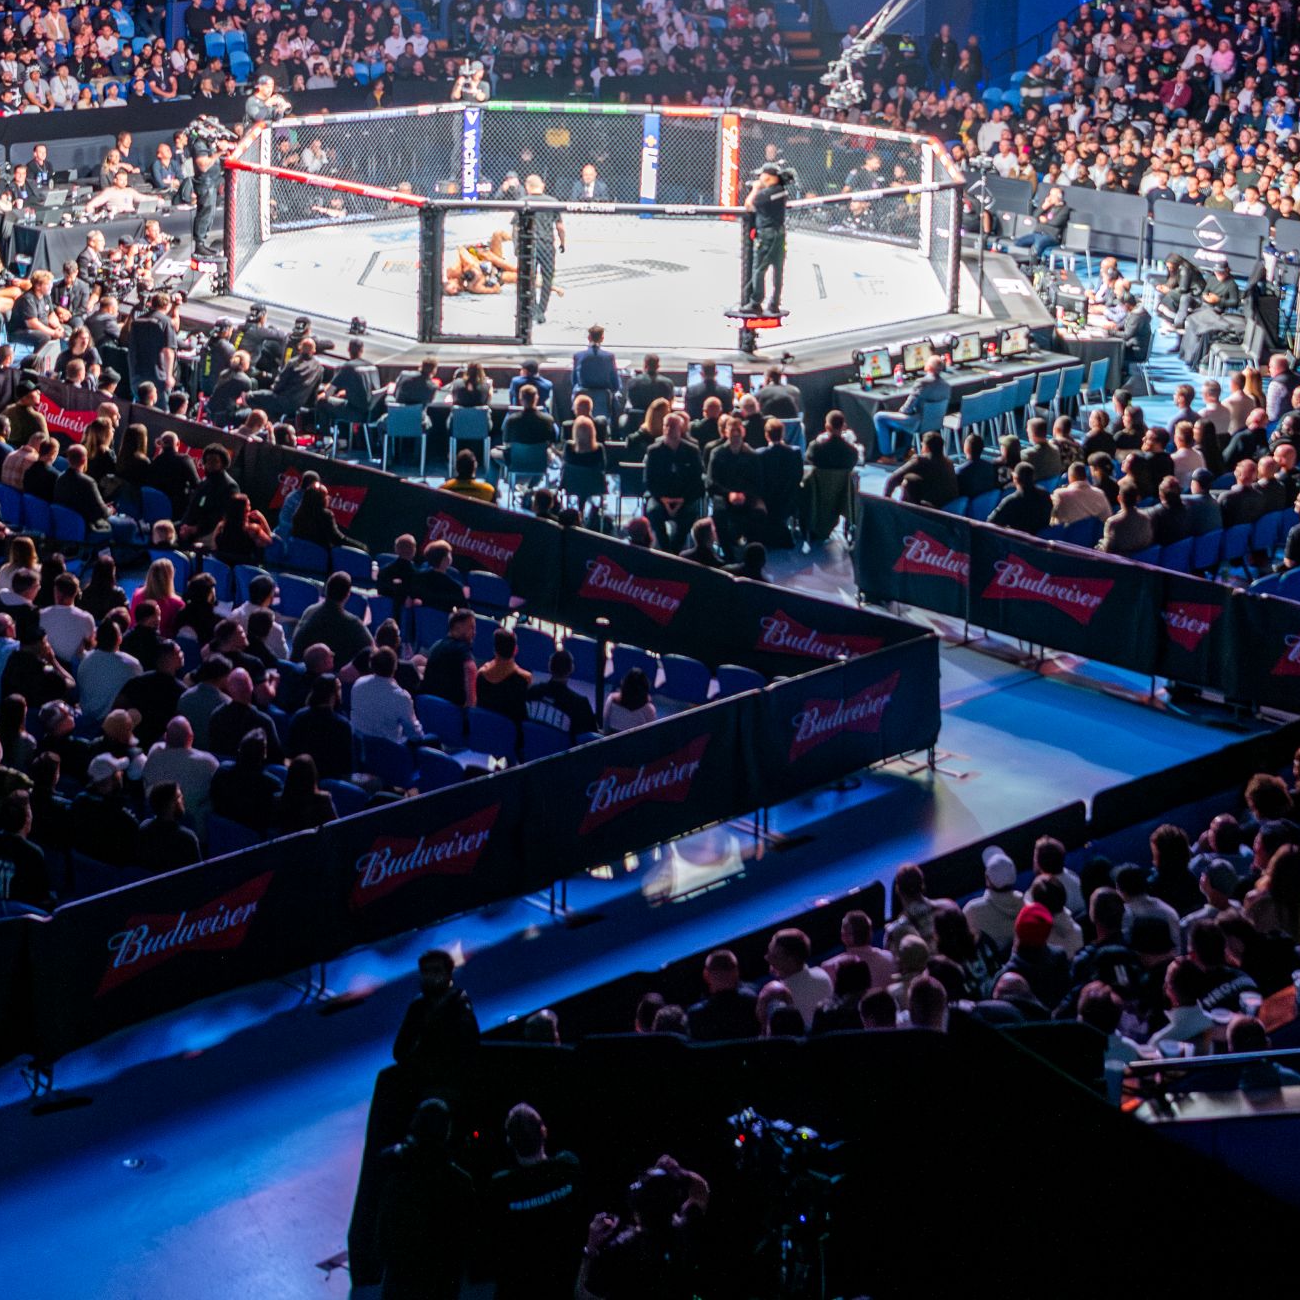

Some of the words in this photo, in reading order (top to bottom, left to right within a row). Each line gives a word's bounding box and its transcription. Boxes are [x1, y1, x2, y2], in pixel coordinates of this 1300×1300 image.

[427, 513, 515, 561] Budweiser
[586, 559, 680, 612] Budweiser
[994, 560, 1102, 607] Budweiser
[792, 694, 891, 742] Budweiser
[586, 761, 699, 813] Budweiser
[356, 828, 490, 888] Budweiser
[108, 901, 258, 969] Budweiser
